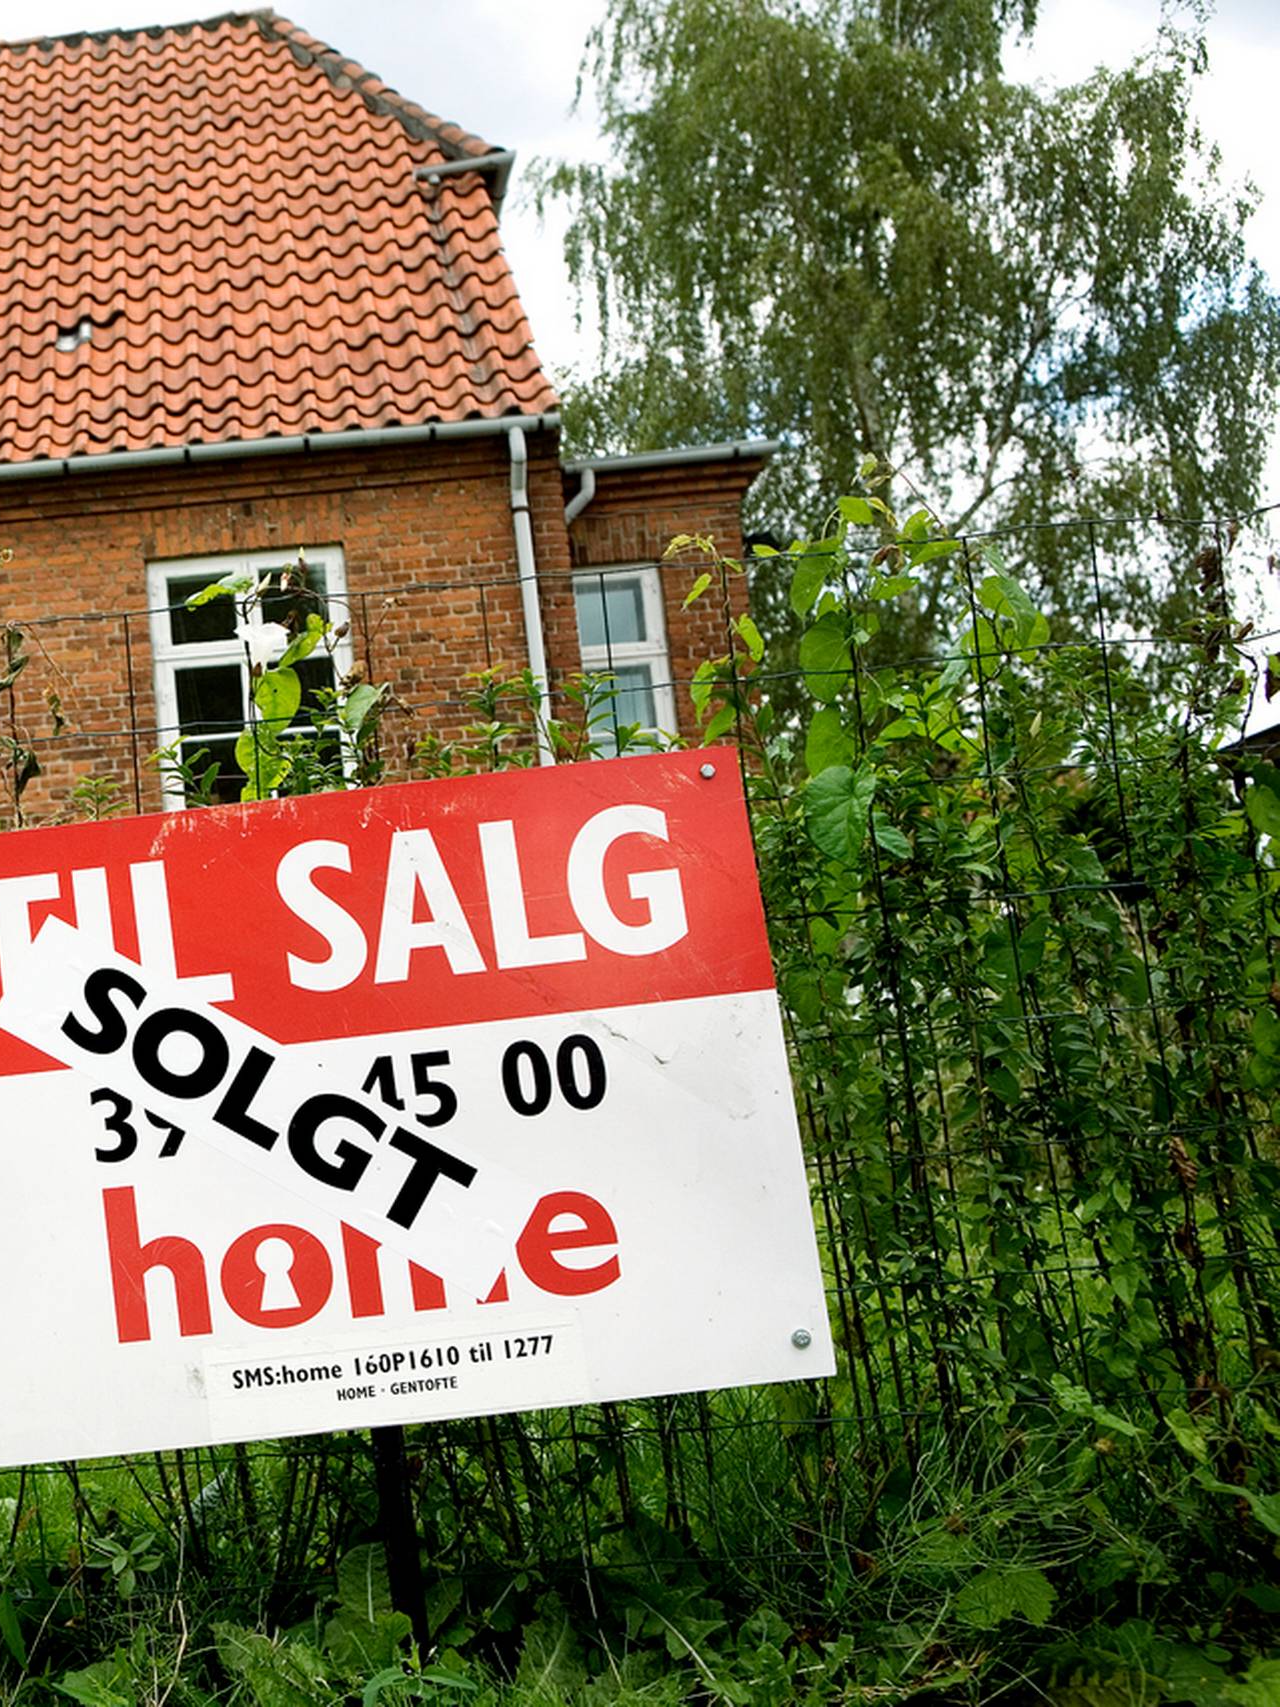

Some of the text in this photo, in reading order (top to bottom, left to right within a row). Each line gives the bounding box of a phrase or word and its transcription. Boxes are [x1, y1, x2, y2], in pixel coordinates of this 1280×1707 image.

[276, 804, 689, 992] SALG
[60, 968, 478, 1230] SOLGT
[501, 1034, 607, 1117] 00
[232, 1334, 554, 1390] SMS:home 160P1610 til 1277
[336, 1385, 376, 1401] HOME
[390, 1375, 458, 1395] GENTOFTE
